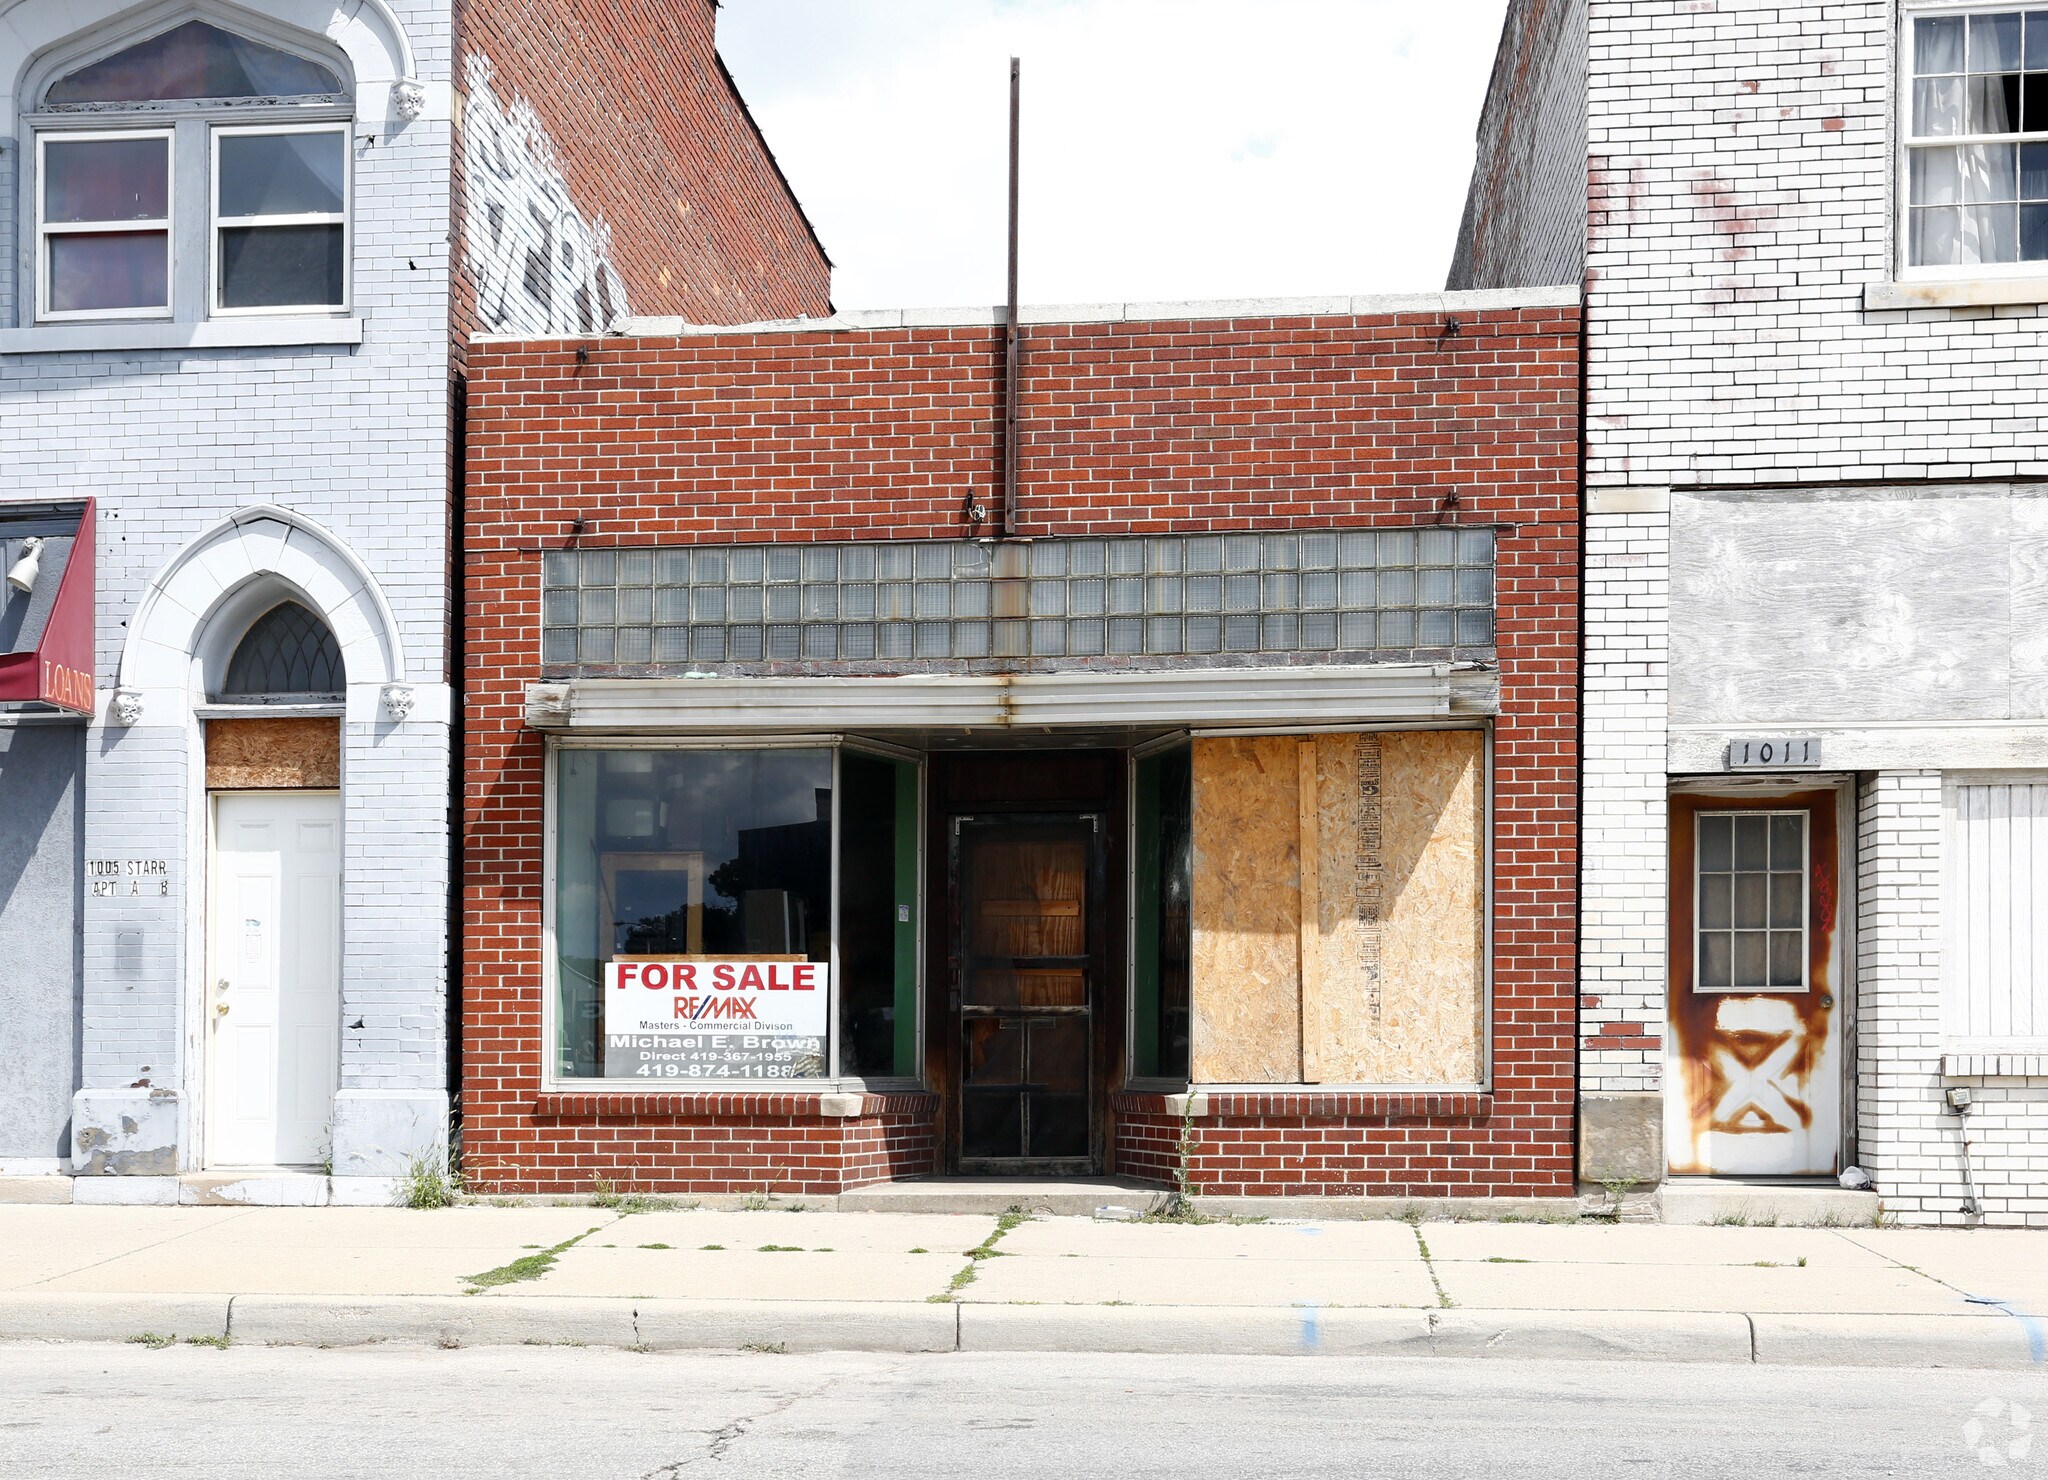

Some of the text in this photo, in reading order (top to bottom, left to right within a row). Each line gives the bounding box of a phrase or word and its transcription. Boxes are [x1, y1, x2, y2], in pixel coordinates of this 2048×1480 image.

[44, 660, 92, 710] LOANS
[1743, 740, 1809, 765] 1011
[90, 860, 167, 875] 1005 STARR
[93, 880, 168, 896] APT A B
[617, 963, 815, 991] FOR SALE
[673, 995, 757, 1020] RE/MAX
[639, 1021, 680, 1031] Masters
[689, 1021, 751, 1031] Commercial
[754, 1021, 793, 1031] Divison
[610, 1035, 821, 1050] Michael E. Brown
[640, 1052, 792, 1062] Direct 419-367-1955
[636, 1064, 795, 1078] 419-874-1188
